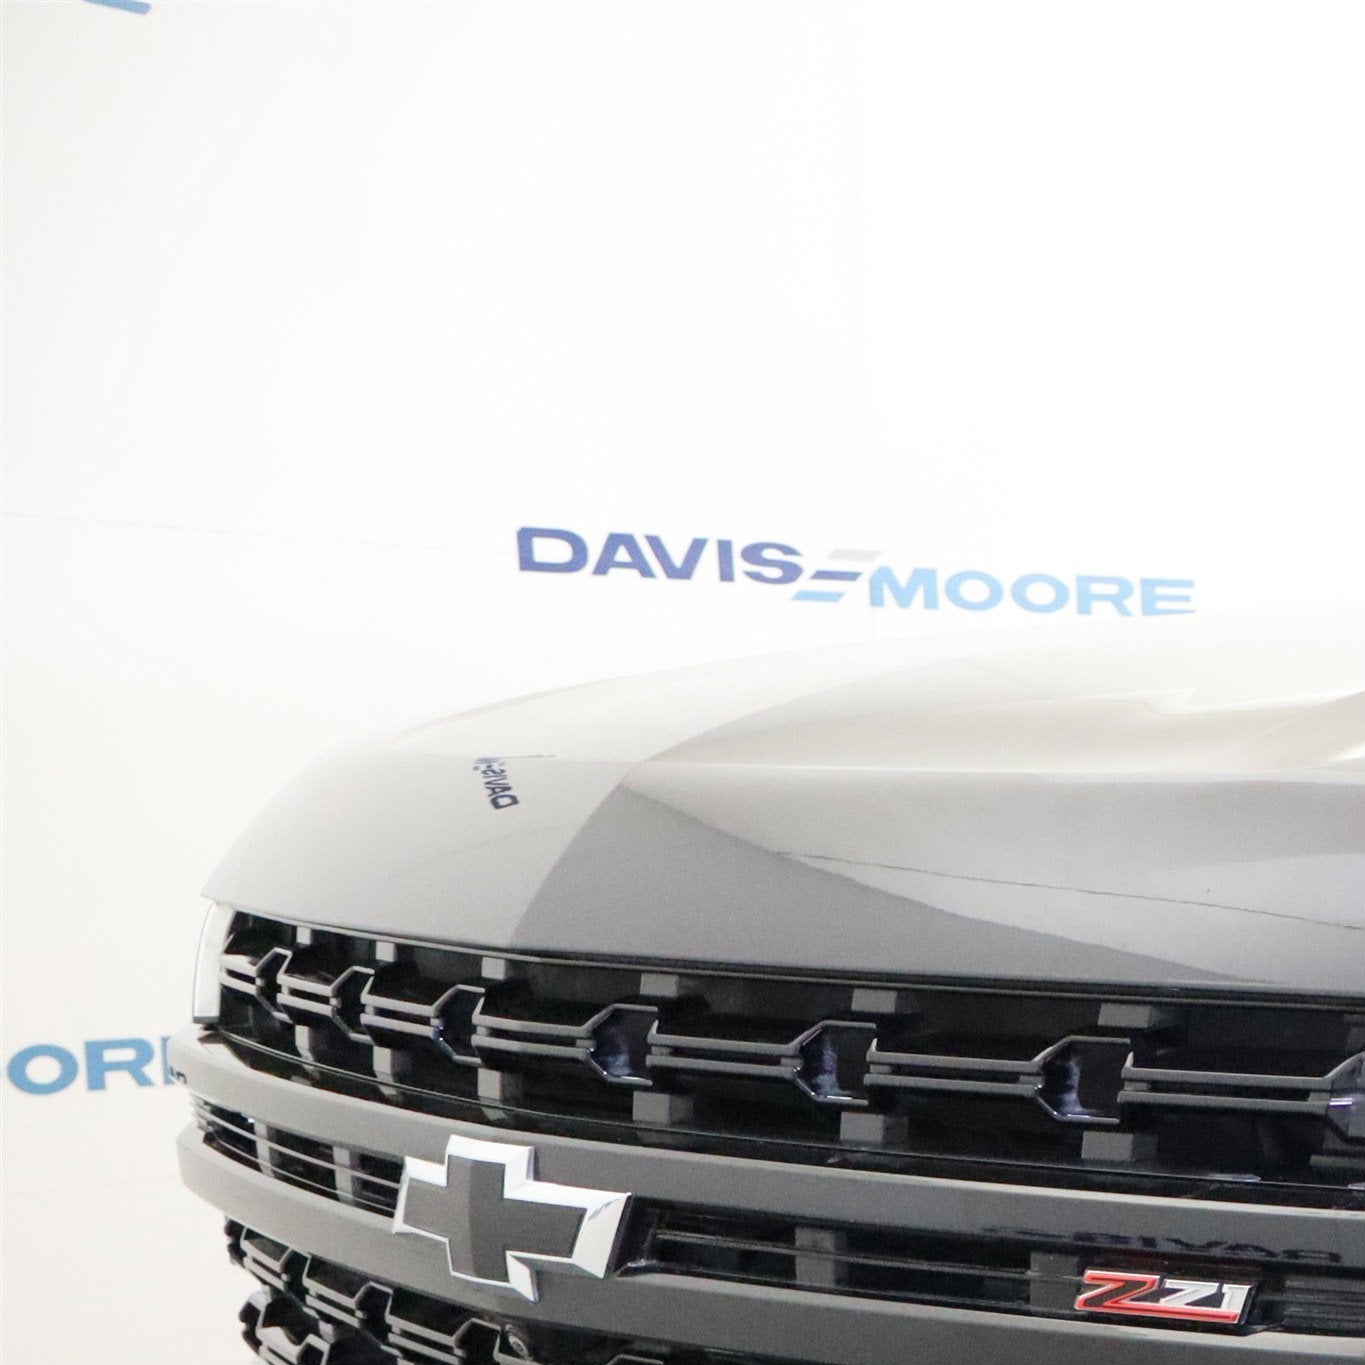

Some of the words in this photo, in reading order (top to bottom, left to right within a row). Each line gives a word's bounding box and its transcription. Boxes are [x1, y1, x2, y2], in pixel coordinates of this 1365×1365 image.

[516, 526, 804, 584] DAVIS
[869, 565, 1197, 617] MOORE
[6, 1036, 176, 1095] OR
[1074, 1269, 1256, 1325] Z71
